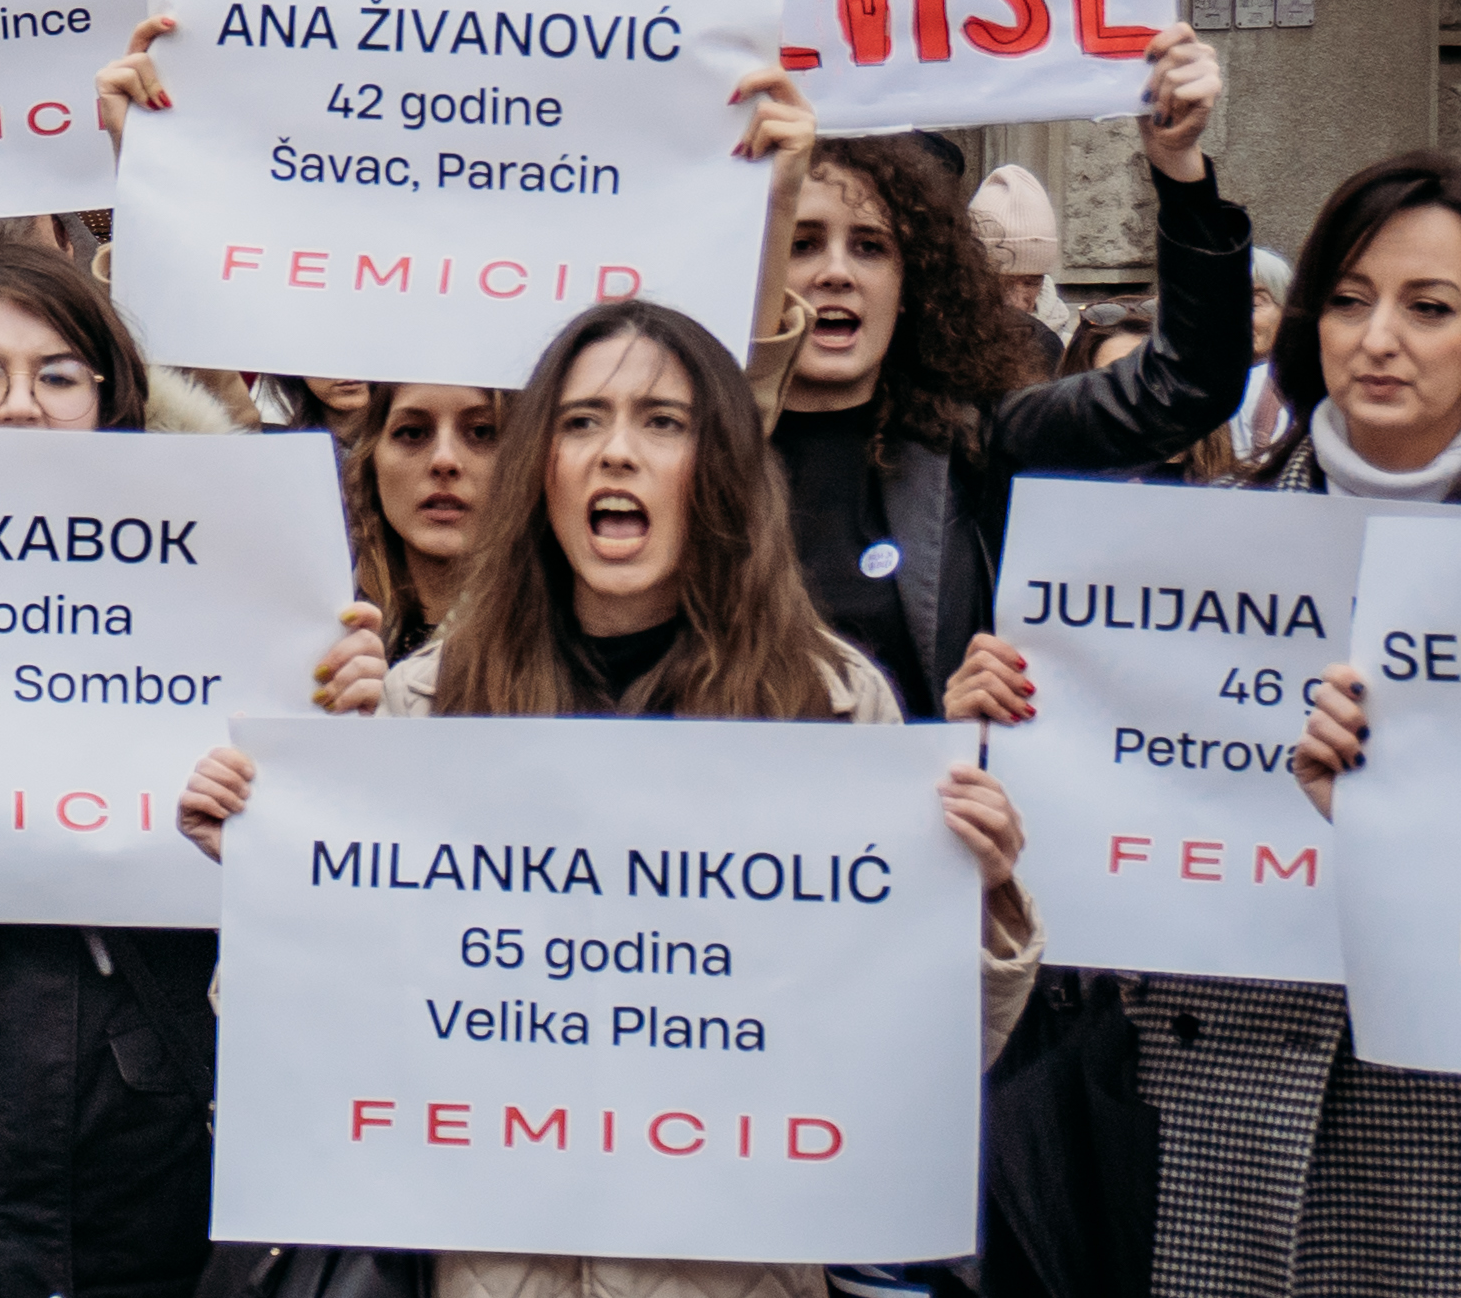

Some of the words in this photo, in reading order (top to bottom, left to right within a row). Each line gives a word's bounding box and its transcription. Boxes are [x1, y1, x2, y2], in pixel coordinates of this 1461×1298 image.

[217, 4, 337, 49] ANA
[328, 84, 383, 119] 42
[401, 87, 562, 130] godine
[271, 137, 419, 192] Šavac,
[439, 153, 619, 194] Paraćin
[219, 241, 644, 306] FEMICID
[1024, 581, 1326, 638] JULIJANA
[15, 665, 221, 705] Sombor
[1220, 668, 1282, 706] 46
[313, 841, 602, 895] MILANKA
[629, 844, 890, 904] NIKOLIĆ
[462, 928, 524, 969] 65
[546, 931, 731, 980] godina
[427, 1000, 588, 1045] Velika
[613, 1007, 764, 1051] Plana
[353, 1101, 842, 1160] FEMICID
